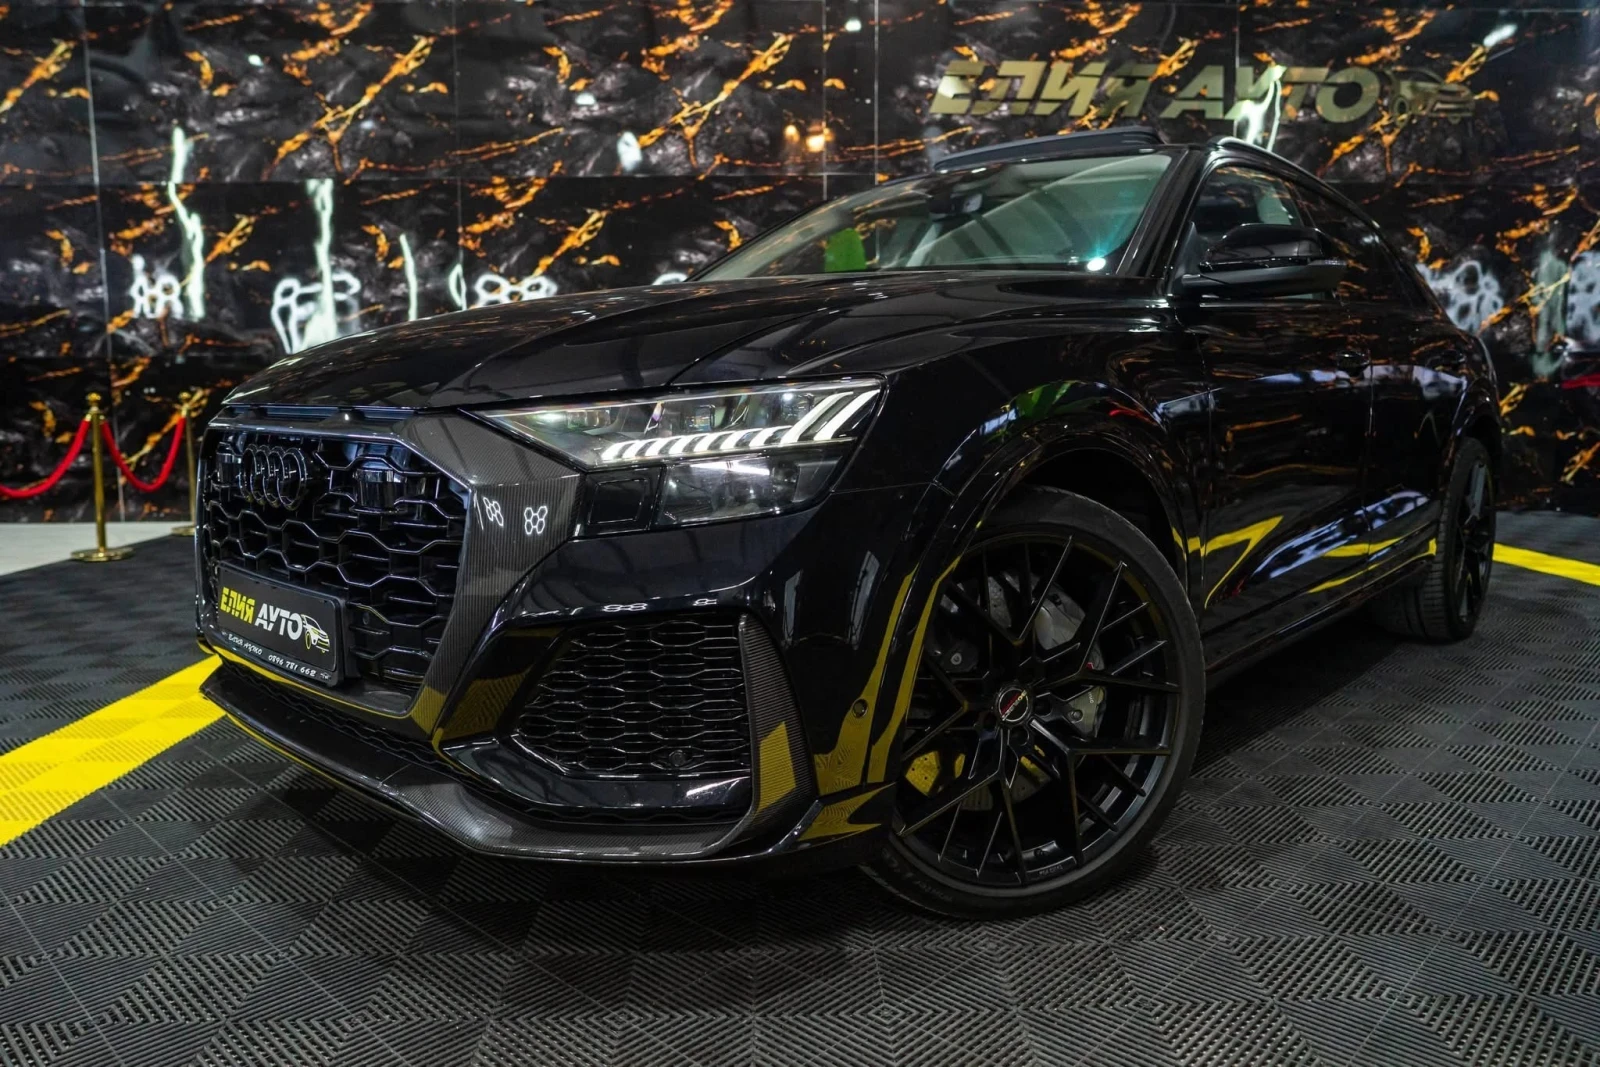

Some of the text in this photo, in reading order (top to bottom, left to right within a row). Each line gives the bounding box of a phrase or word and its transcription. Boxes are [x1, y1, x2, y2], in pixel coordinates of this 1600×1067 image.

[929, 61, 1380, 123] ЕЛИЯ АУТО
[220, 586, 303, 640] ЕЛИЯ АУТО
[268, 654, 284, 666] 0896
[286, 660, 298, 671] 781
[300, 666, 317, 677] 662
